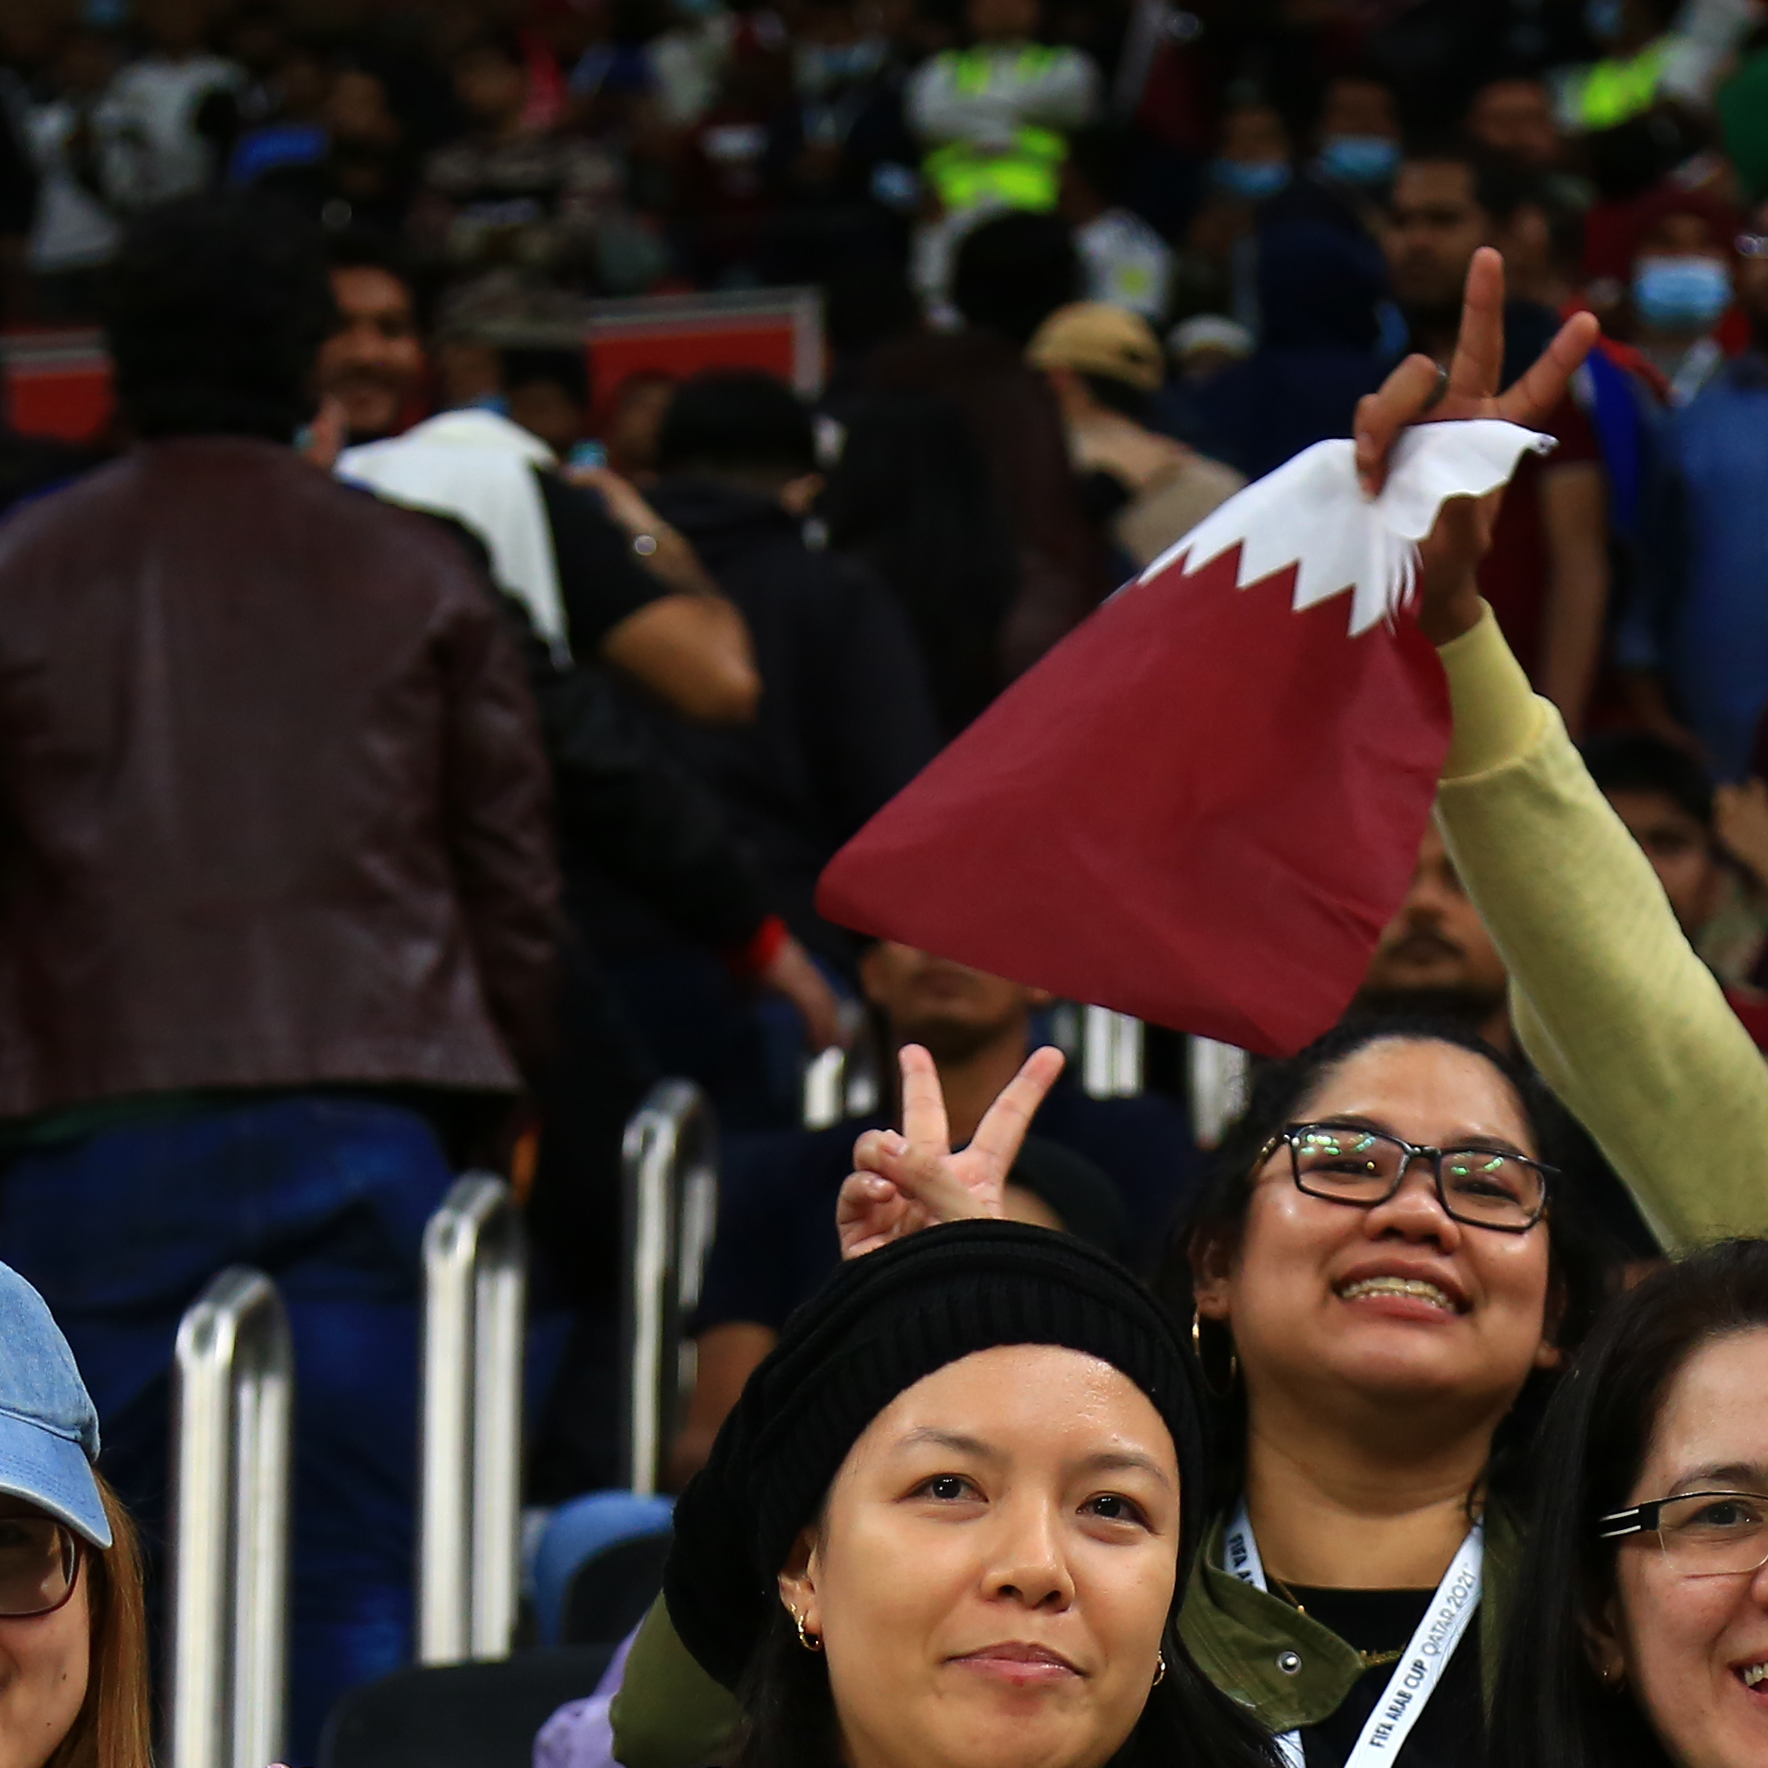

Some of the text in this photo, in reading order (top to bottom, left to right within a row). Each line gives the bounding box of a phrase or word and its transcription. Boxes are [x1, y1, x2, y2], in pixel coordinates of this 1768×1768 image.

[1370, 1569, 1477, 1748] FIFA ARAB CUP QATAR 2021
